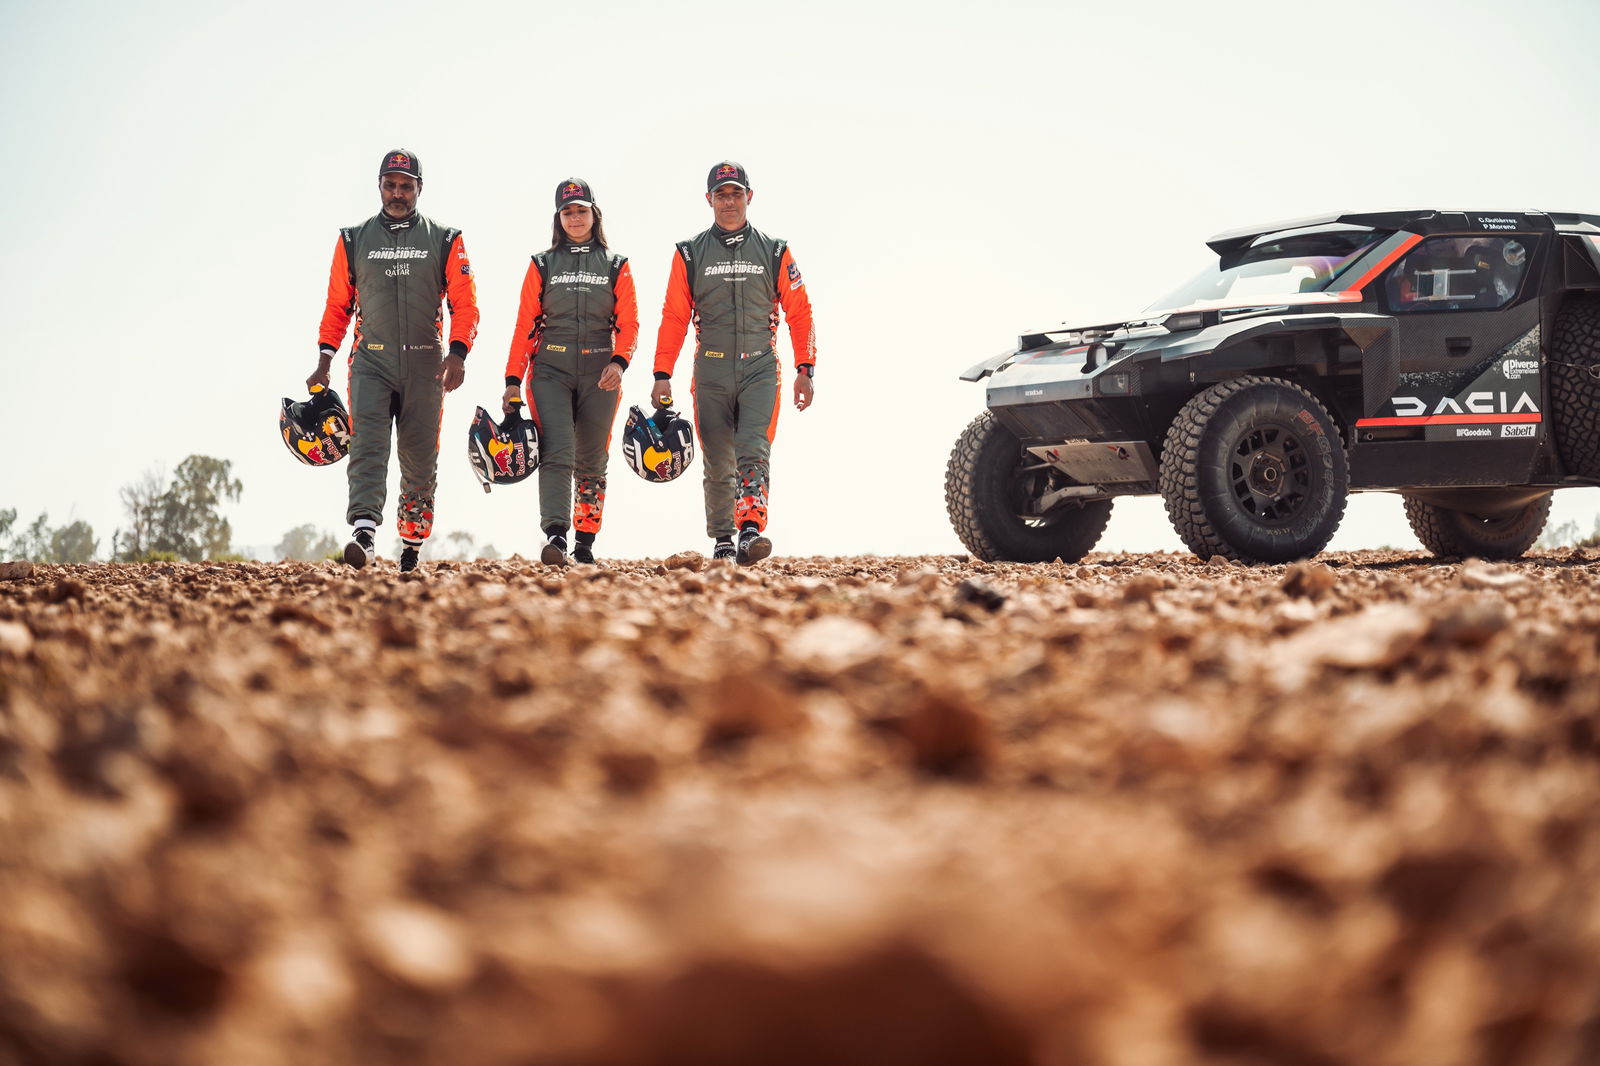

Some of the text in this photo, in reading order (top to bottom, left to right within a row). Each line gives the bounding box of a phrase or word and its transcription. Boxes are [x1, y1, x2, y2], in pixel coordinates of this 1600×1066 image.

[367, 250, 429, 259] SANDRIDERS
[392, 262, 410, 270] visit
[704, 264, 765, 276] SANDRIDERS
[385, 268, 410, 277] QATAR
[550, 274, 609, 285] SANDRIDERS
[1509, 359, 1539, 370] Diverse
[1391, 391, 1540, 417] DACIA
[1456, 428, 1492, 437] BFGoodrich
[1504, 425, 1532, 437] Sabelt
[513, 442, 525, 460] Bull
